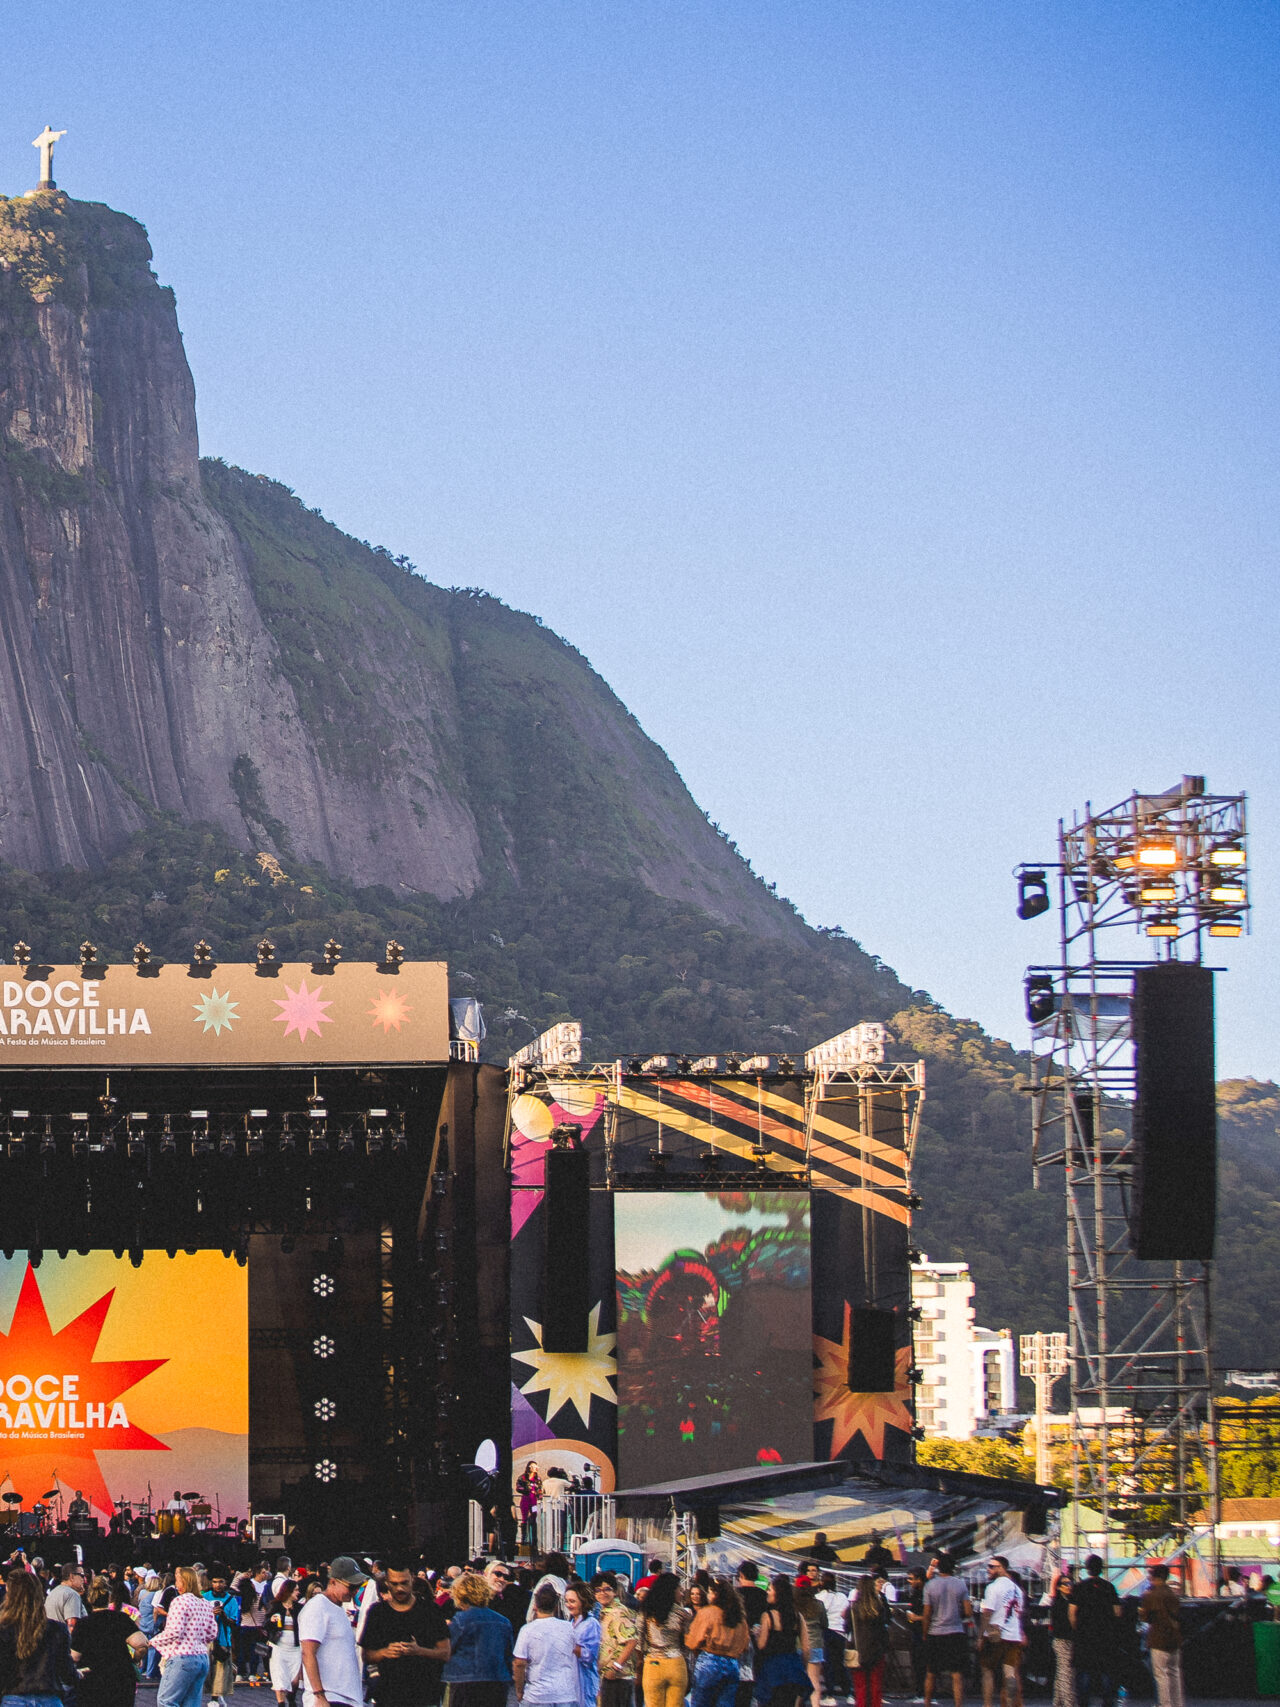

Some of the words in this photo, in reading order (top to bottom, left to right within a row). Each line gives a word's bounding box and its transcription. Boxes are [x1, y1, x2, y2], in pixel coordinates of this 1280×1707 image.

[3, 980, 100, 1007] DOCE
[6, 1037, 27, 1046] Festa
[28, 1037, 39, 1046] da
[40, 1037, 69, 1046] Música
[70, 1037, 106, 1046] Brasileira
[9, 1431, 20, 1439] da
[21, 1431, 48, 1439] Música
[50, 1430, 85, 1439] Brasileira
